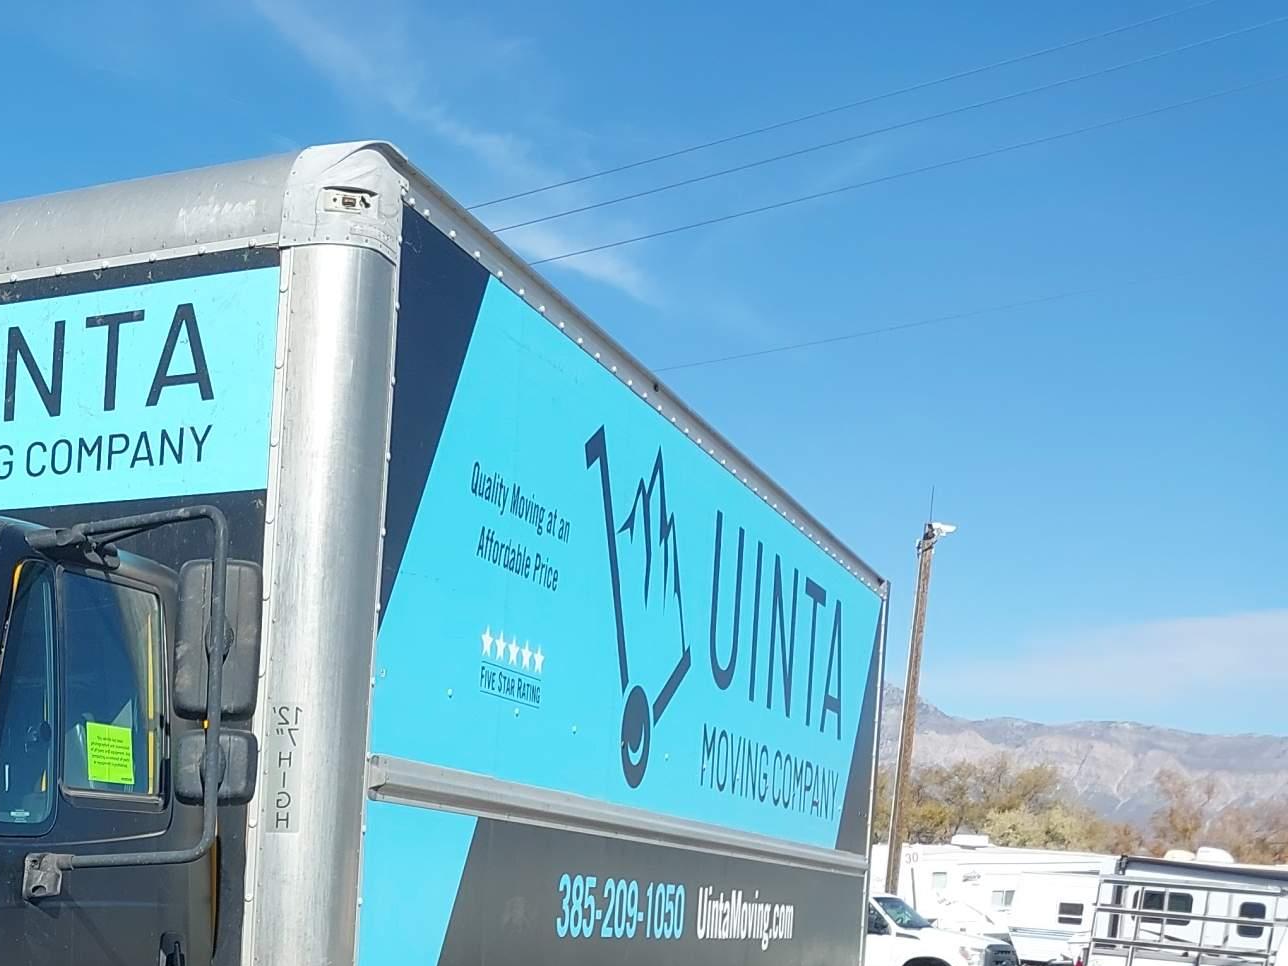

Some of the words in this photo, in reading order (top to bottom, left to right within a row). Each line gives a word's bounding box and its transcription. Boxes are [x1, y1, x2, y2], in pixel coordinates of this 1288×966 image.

[26, 424, 213, 477] COMPANY
[471, 461, 510, 516] Quality
[510, 483, 546, 536] Moving
[546, 509, 558, 537] at
[558, 518, 571, 544] an
[476, 526, 531, 579] Affordable
[533, 553, 559, 592] Price
[709, 509, 843, 741] UINTA
[700, 722, 769, 803] MOVING
[772, 748, 839, 822] COMPANY
[556, 872, 686, 939] 385-209-1050
[696, 885, 795, 951] UintaMoving.com
